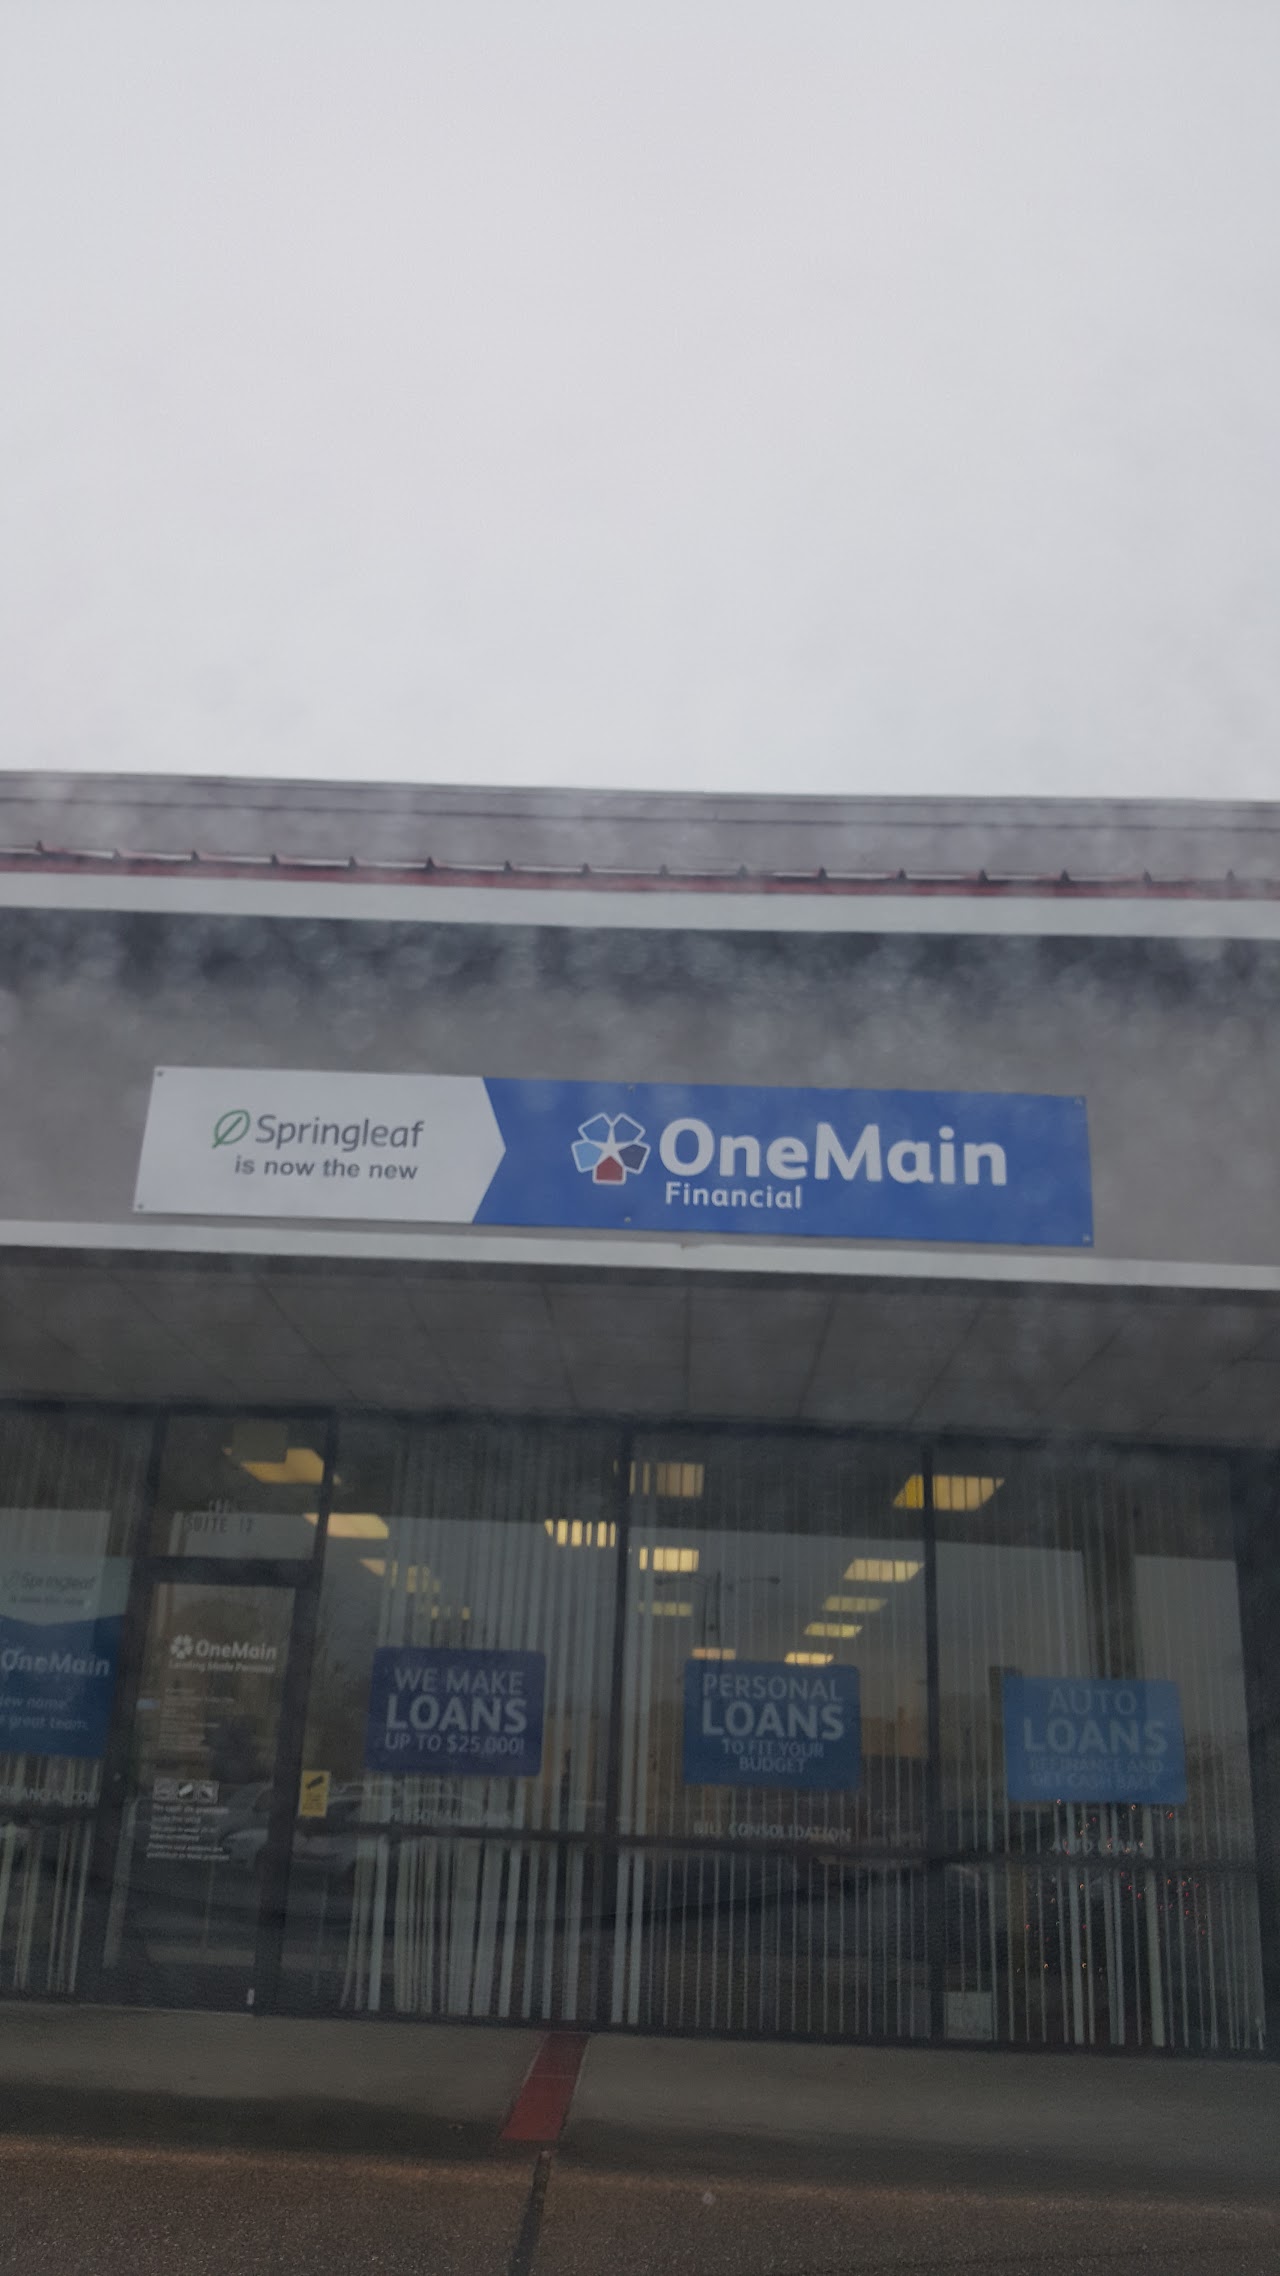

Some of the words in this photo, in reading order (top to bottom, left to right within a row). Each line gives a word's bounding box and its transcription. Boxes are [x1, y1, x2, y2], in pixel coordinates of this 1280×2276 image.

[255, 1114, 425, 1153] Springleaf
[658, 1117, 1008, 1187] OneMain
[234, 1154, 255, 1175] is
[263, 1160, 314, 1178] now
[322, 1158, 361, 1179] the
[368, 1162, 418, 1180] new
[664, 1182, 802, 1210] Financial
[1, 1648, 110, 1677] OneMain
[195, 1638, 278, 1661] OneMain
[393, 1666, 439, 1693] WE
[446, 1668, 524, 1696] MAKE
[703, 1673, 844, 1702] PERSONAL
[385, 1693, 528, 1734] LOANS
[1047, 1687, 1137, 1716] AUTO
[702, 1699, 846, 1741] LOANS
[384, 1731, 411, 1750] UP
[416, 1733, 441, 1752] TO
[721, 1739, 746, 1755] TO
[748, 1740, 774, 1756] FIT
[778, 1741, 824, 1759] YOUR
[1023, 1718, 1169, 1755] LOANS
[739, 1756, 808, 1773] BUDGET
